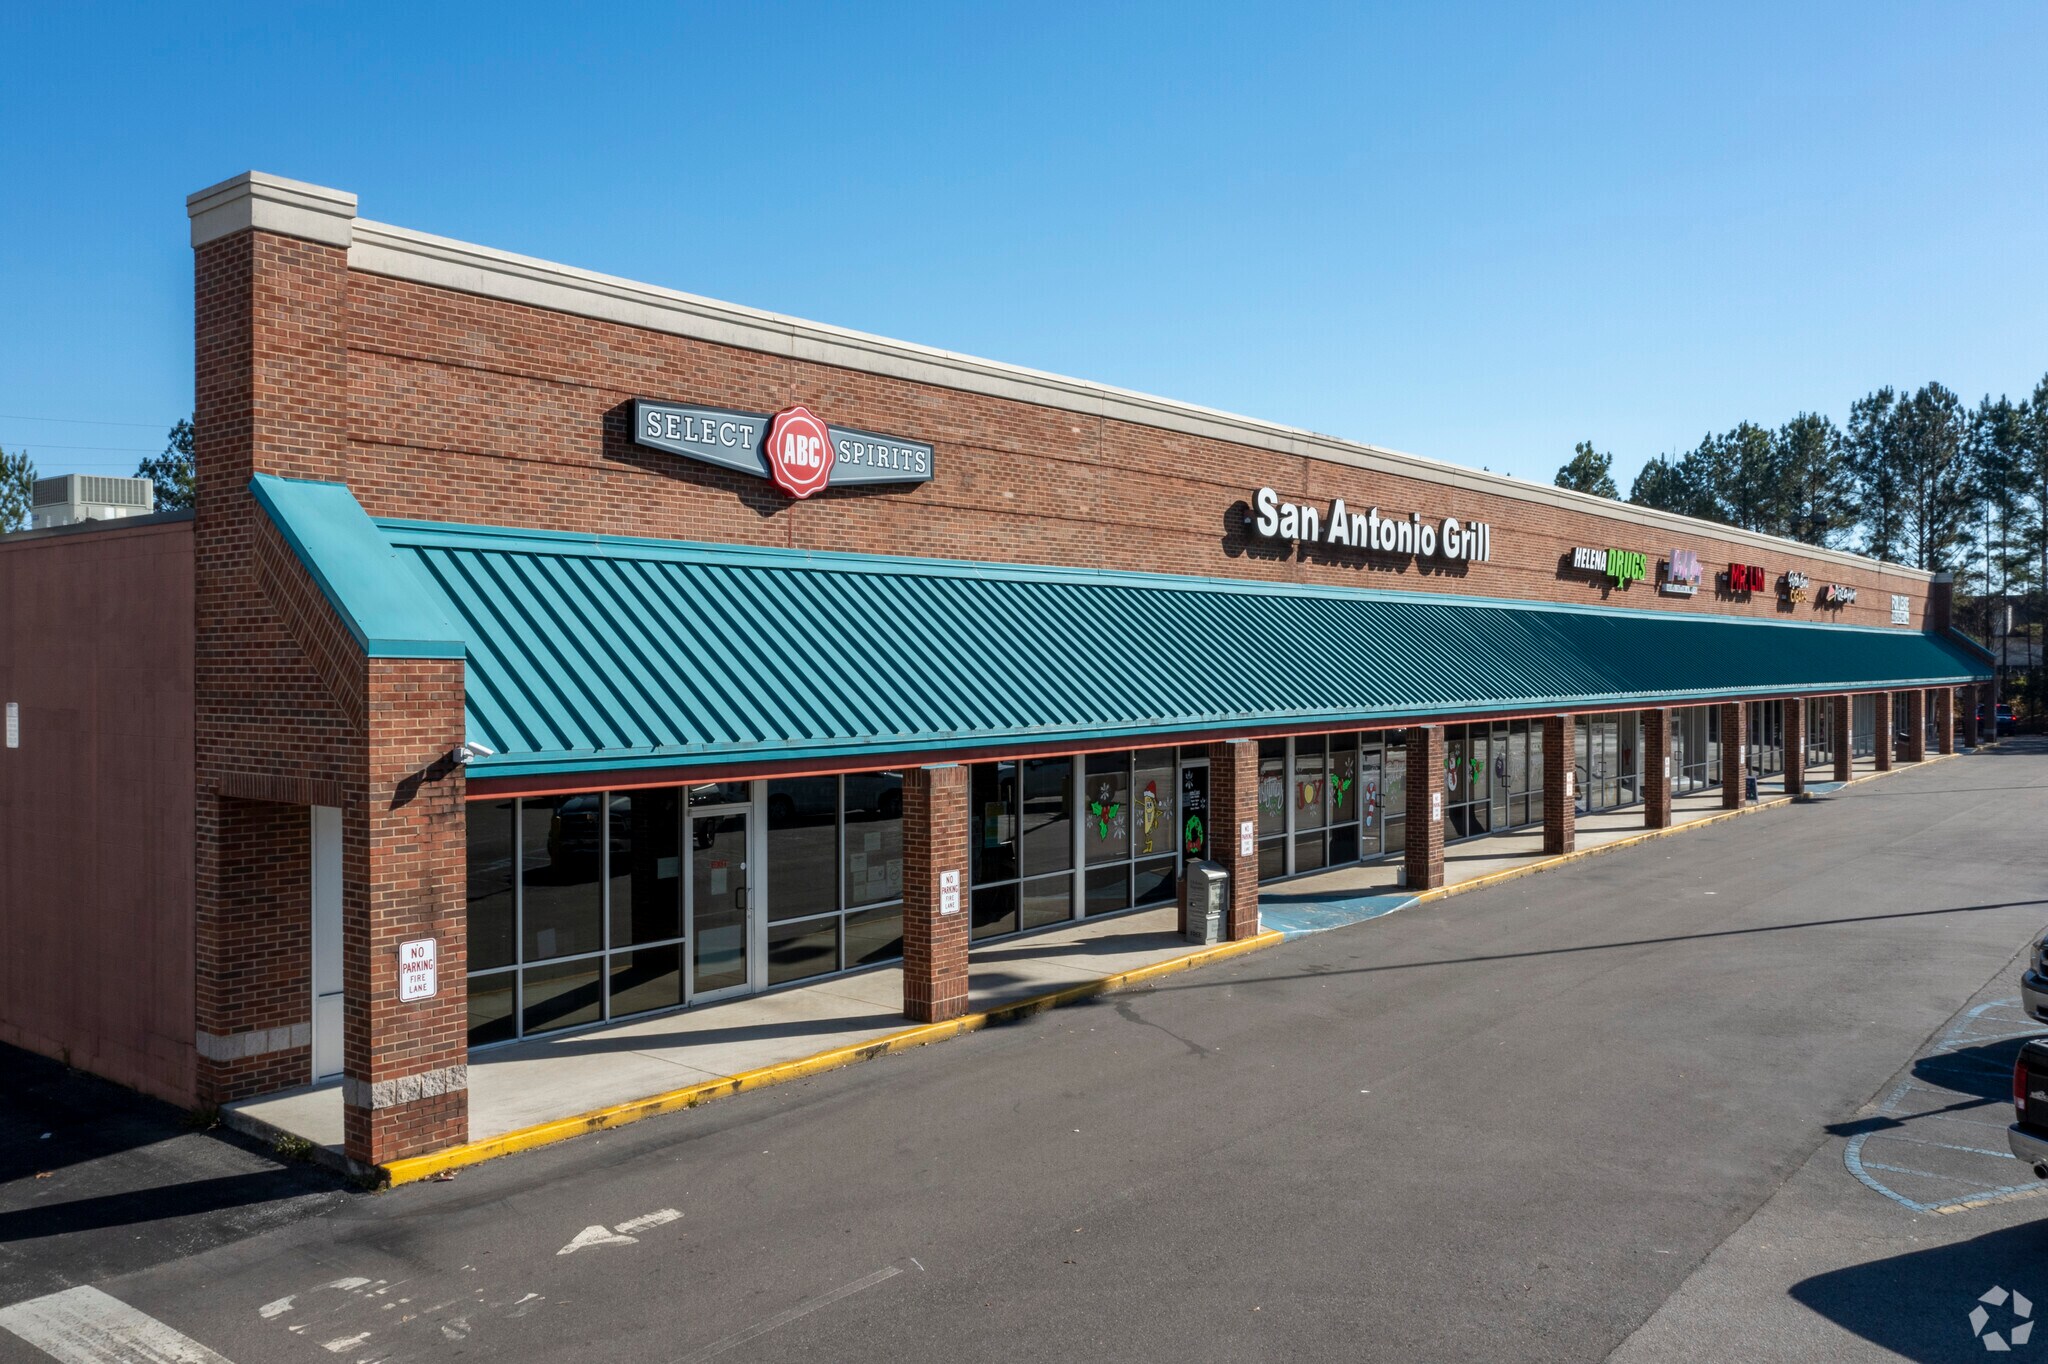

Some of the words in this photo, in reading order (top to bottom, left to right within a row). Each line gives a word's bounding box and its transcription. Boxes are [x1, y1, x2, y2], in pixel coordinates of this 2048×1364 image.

[647, 410, 754, 450] SELECT
[783, 433, 820, 469] ABC
[838, 439, 927, 474] SPIRITS
[1256, 486, 1319, 542] San
[1327, 498, 1436, 557] Antonio
[1442, 517, 1491, 562] Grill
[1573, 546, 1607, 572] HELENA
[1606, 547, 1648, 587] DRUGS
[1730, 563, 1748, 591] MR.
[1749, 565, 1766, 592] LIN
[942, 885, 958, 894] PARKING
[945, 875, 954, 884] NO
[411, 946, 425, 959] NO
[402, 959, 433, 974] PARKING
[409, 983, 427, 993] LANE
[410, 973, 426, 983] FIRE
